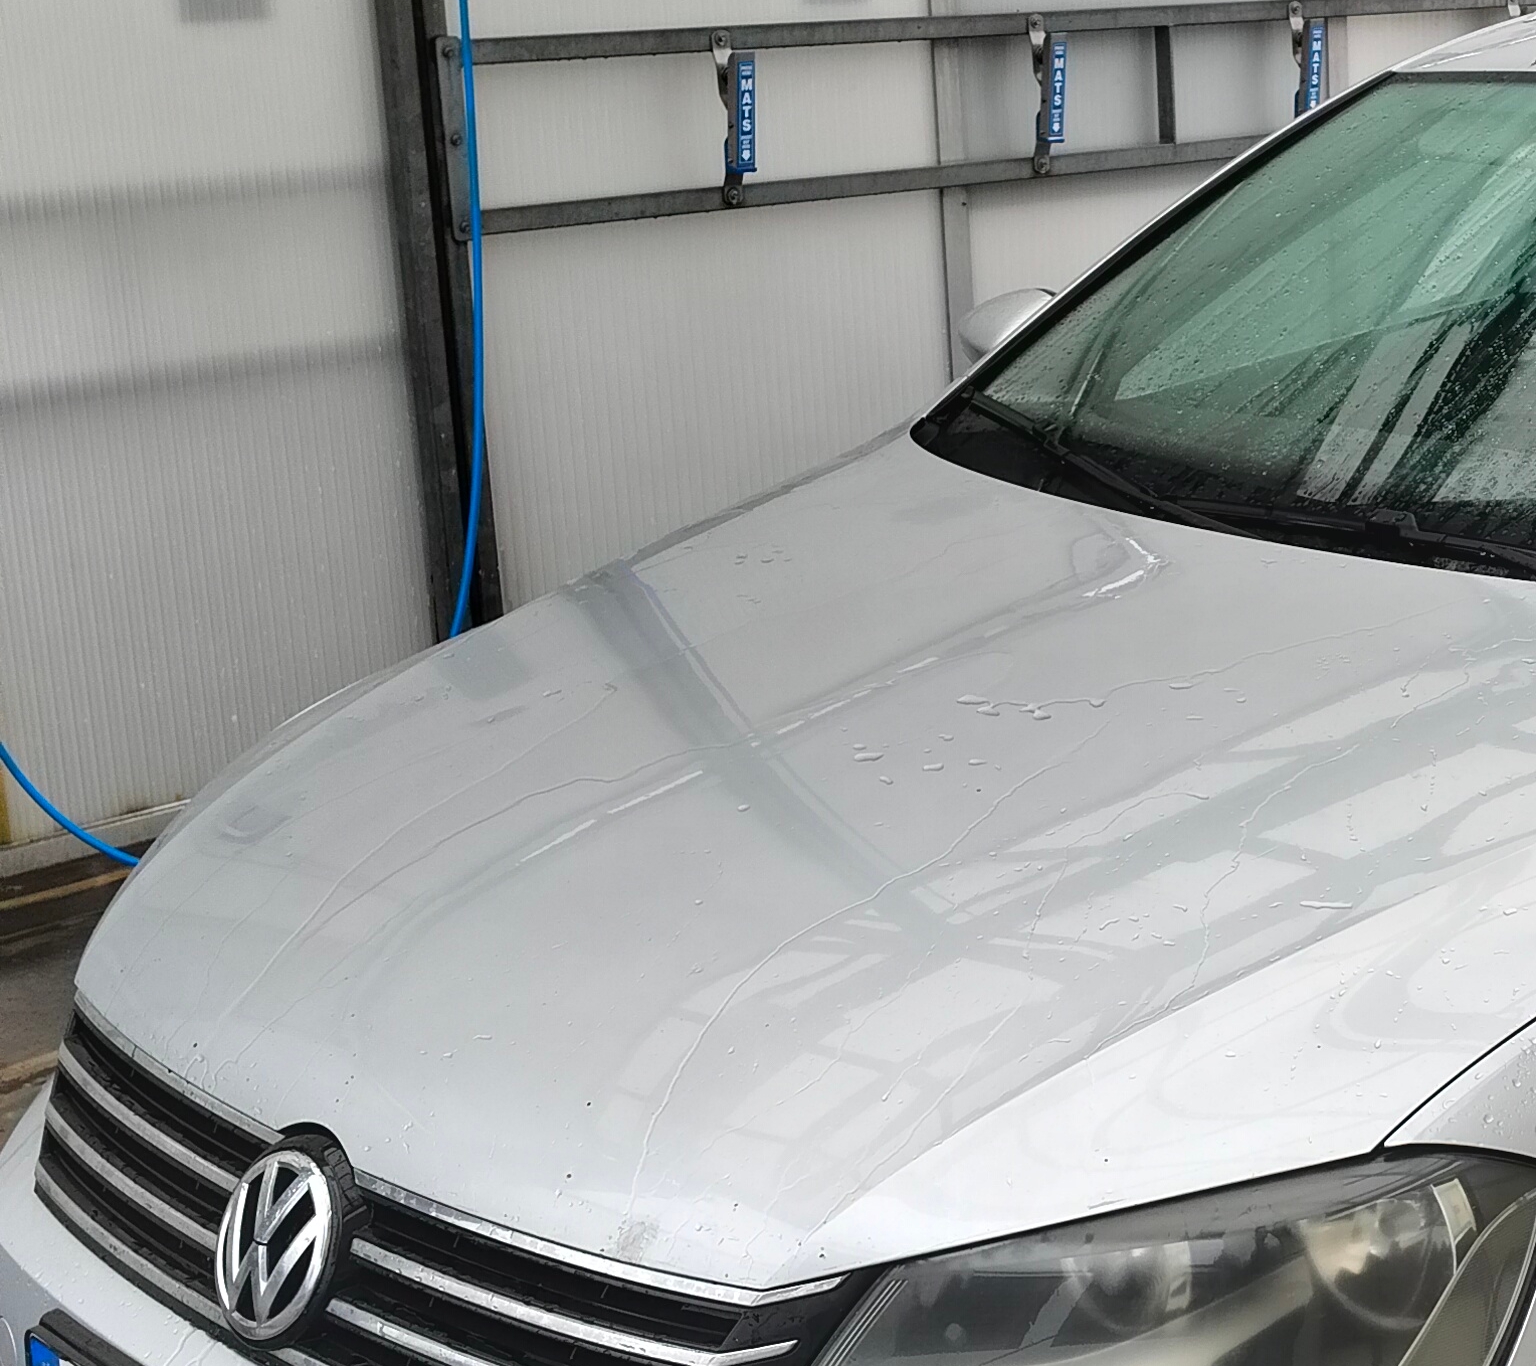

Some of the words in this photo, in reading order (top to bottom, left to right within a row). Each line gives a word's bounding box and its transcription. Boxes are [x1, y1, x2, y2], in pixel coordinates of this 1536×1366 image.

[1053, 57, 1065, 106] MATS
[1311, 40, 1322, 85] MATS
[741, 78, 753, 132] MATS
